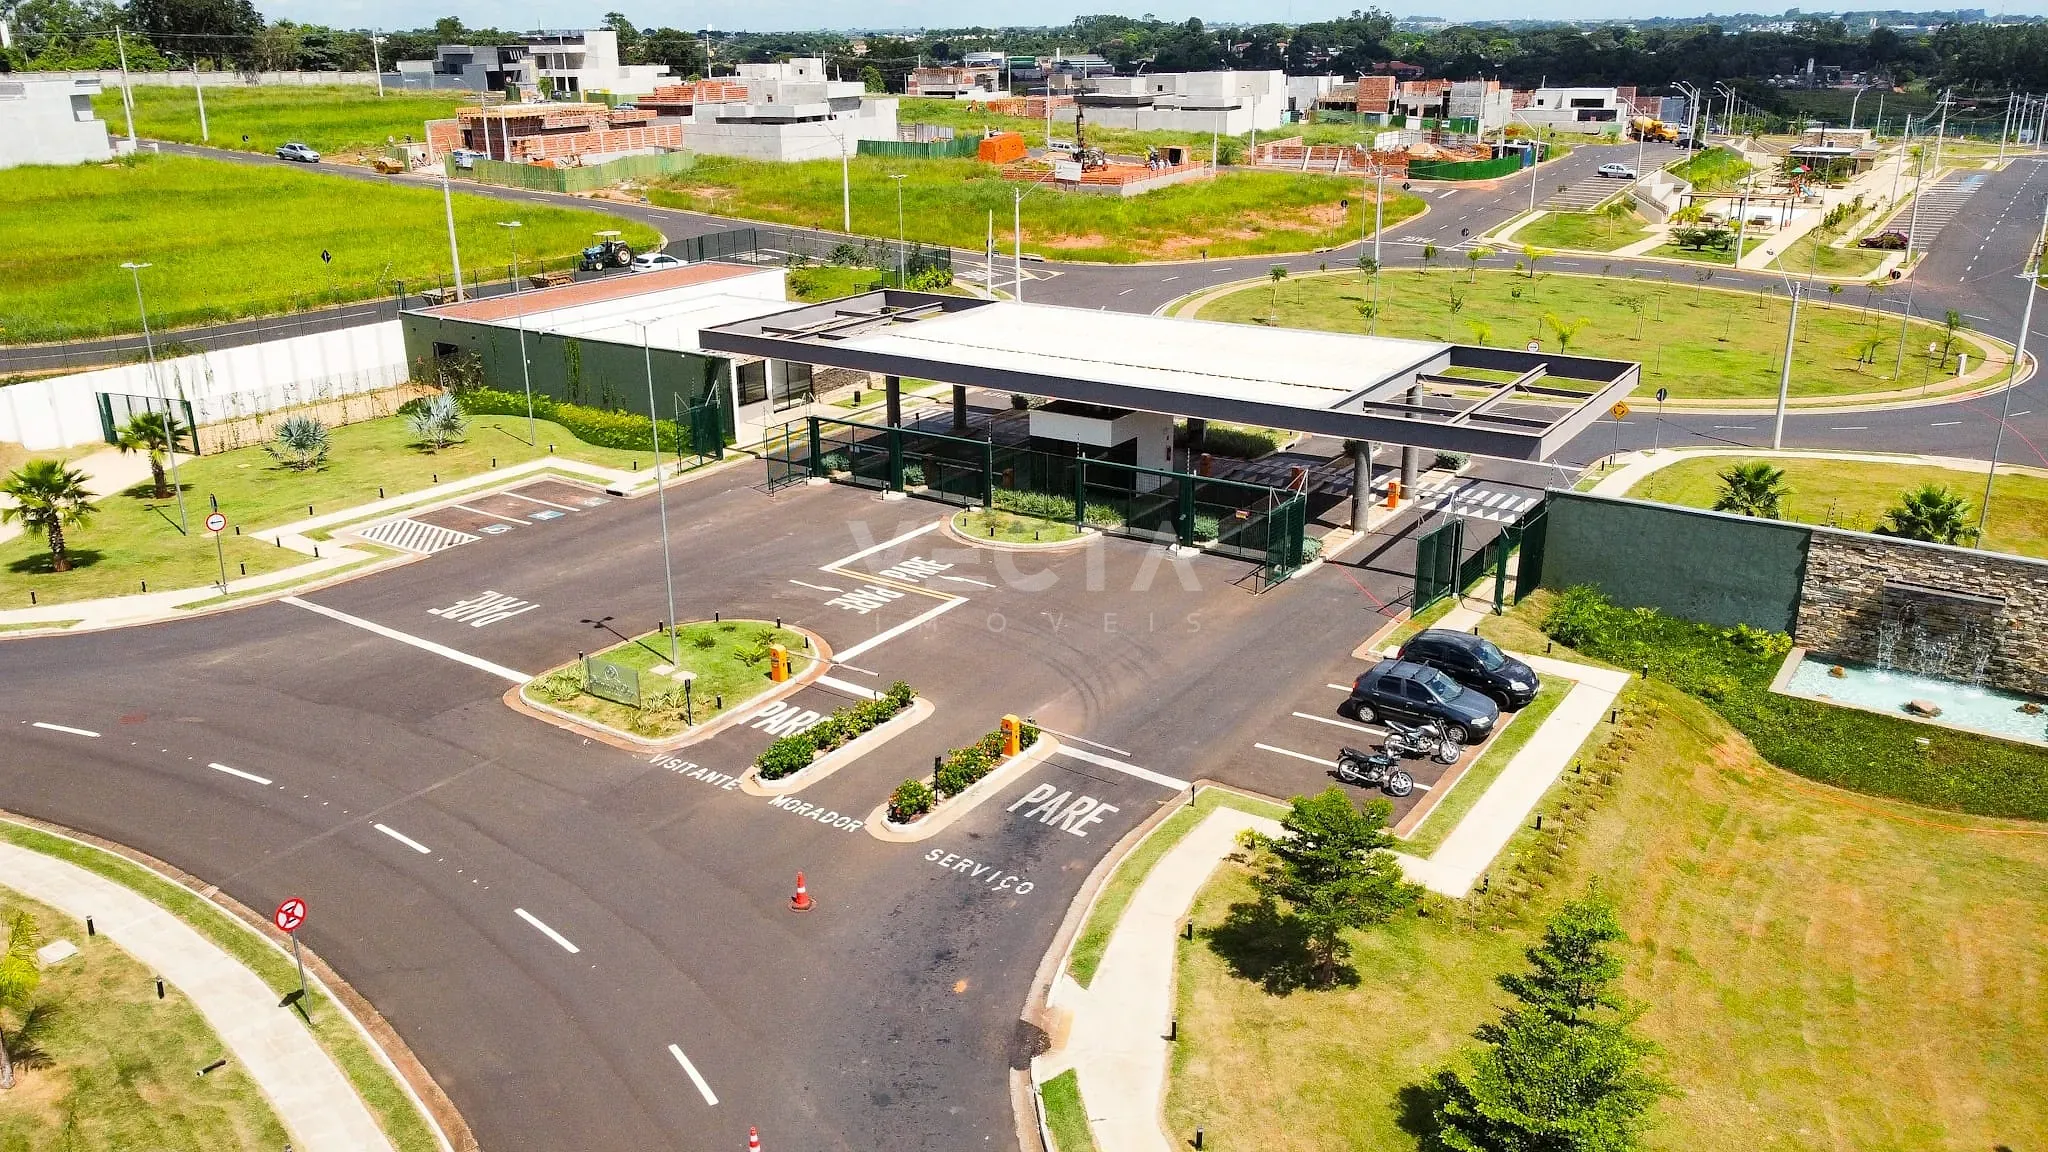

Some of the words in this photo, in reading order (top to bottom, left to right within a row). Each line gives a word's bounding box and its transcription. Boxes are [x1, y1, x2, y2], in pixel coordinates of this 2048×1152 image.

[878, 556, 955, 583] PARE
[426, 590, 541, 628] PARE
[823, 584, 906, 614] PARE
[648, 753, 744, 791] VISITANTE
[767, 793, 865, 833] MORADOR
[1006, 782, 1121, 838] PARE
[924, 848, 1035, 896] SERVIÇO
